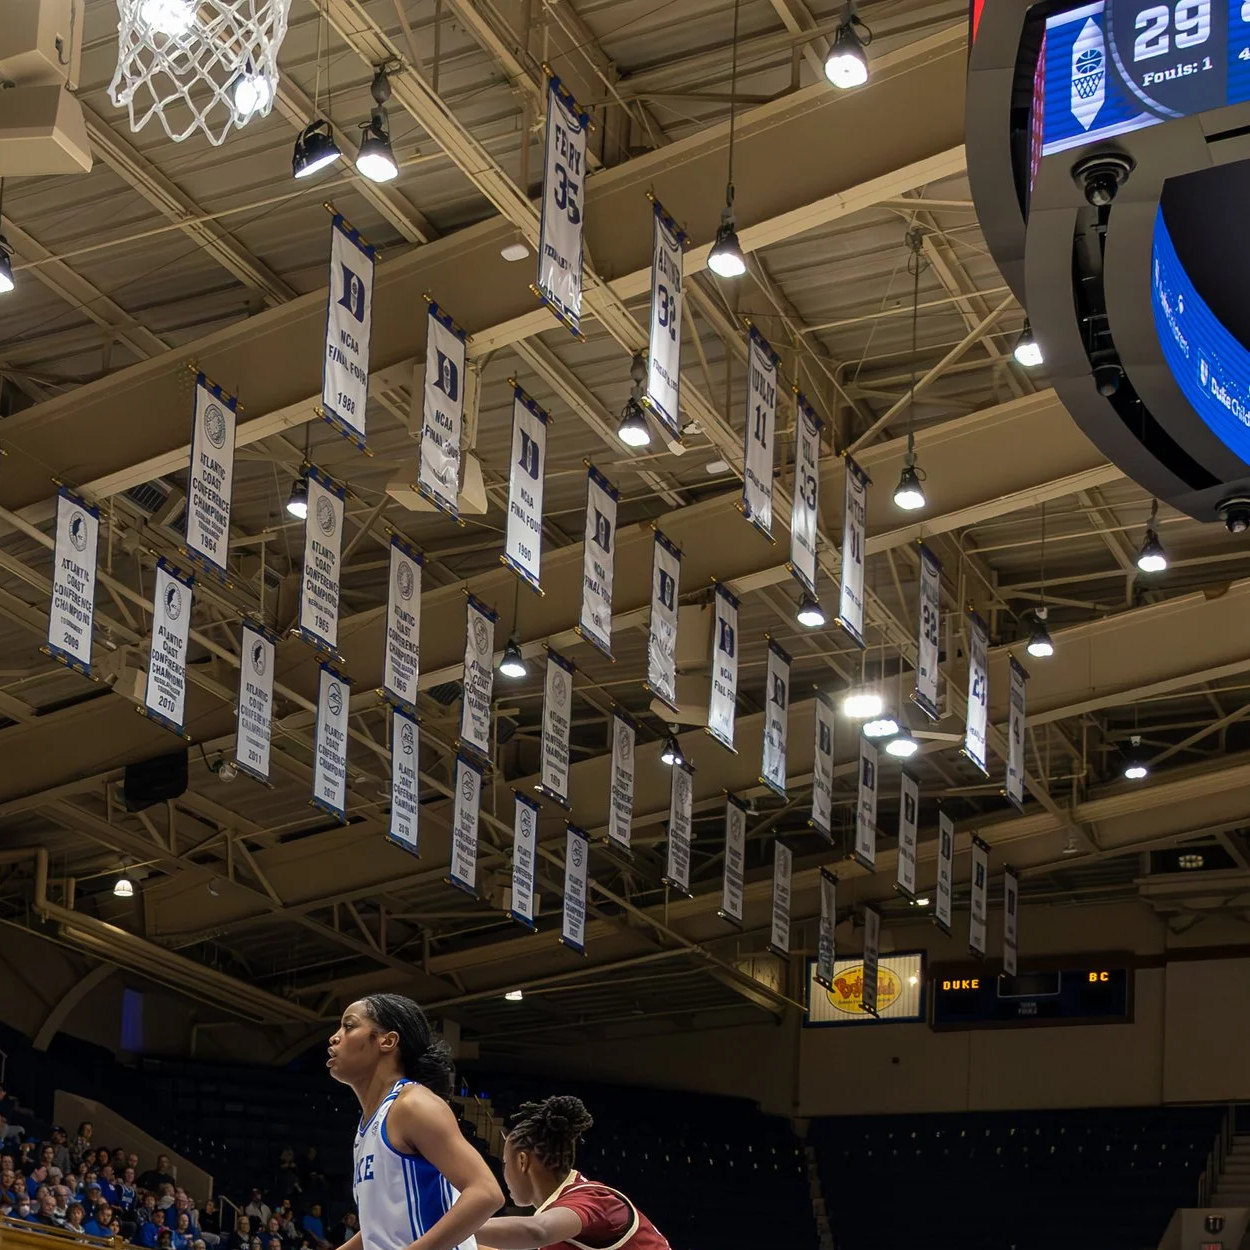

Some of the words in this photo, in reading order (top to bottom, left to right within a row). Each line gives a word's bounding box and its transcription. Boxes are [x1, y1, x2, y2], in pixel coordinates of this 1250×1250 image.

[1134, 0, 1211, 62] 29
[1142, 61, 1199, 87] Fouls:
[1202, 56, 1213, 70] 1
[340, 330, 359, 356] NCAA
[329, 344, 350, 373] FINAL
[337, 393, 355, 415] 1988
[1211, 377, 1231, 410] Duke
[435, 409, 453, 433] NCAA
[200, 452, 226, 481] ATLANTIC
[202, 470, 223, 492] COAST
[192, 477, 230, 515] CONFERENCE
[193, 494, 227, 528] CHAMPIONS
[200, 534, 217, 554] 1964
[61, 558, 90, 583] ATLANTIC
[66, 573, 86, 594] COAST
[54, 581, 92, 614] CONFERENCE
[54, 597, 91, 627] CHAMPIONS
[158, 625, 184, 649] ATLANTIC
[151, 648, 186, 677] CONFERENCE
[158, 695, 176, 714] 2010
[943, 979, 980, 990] DUKE
